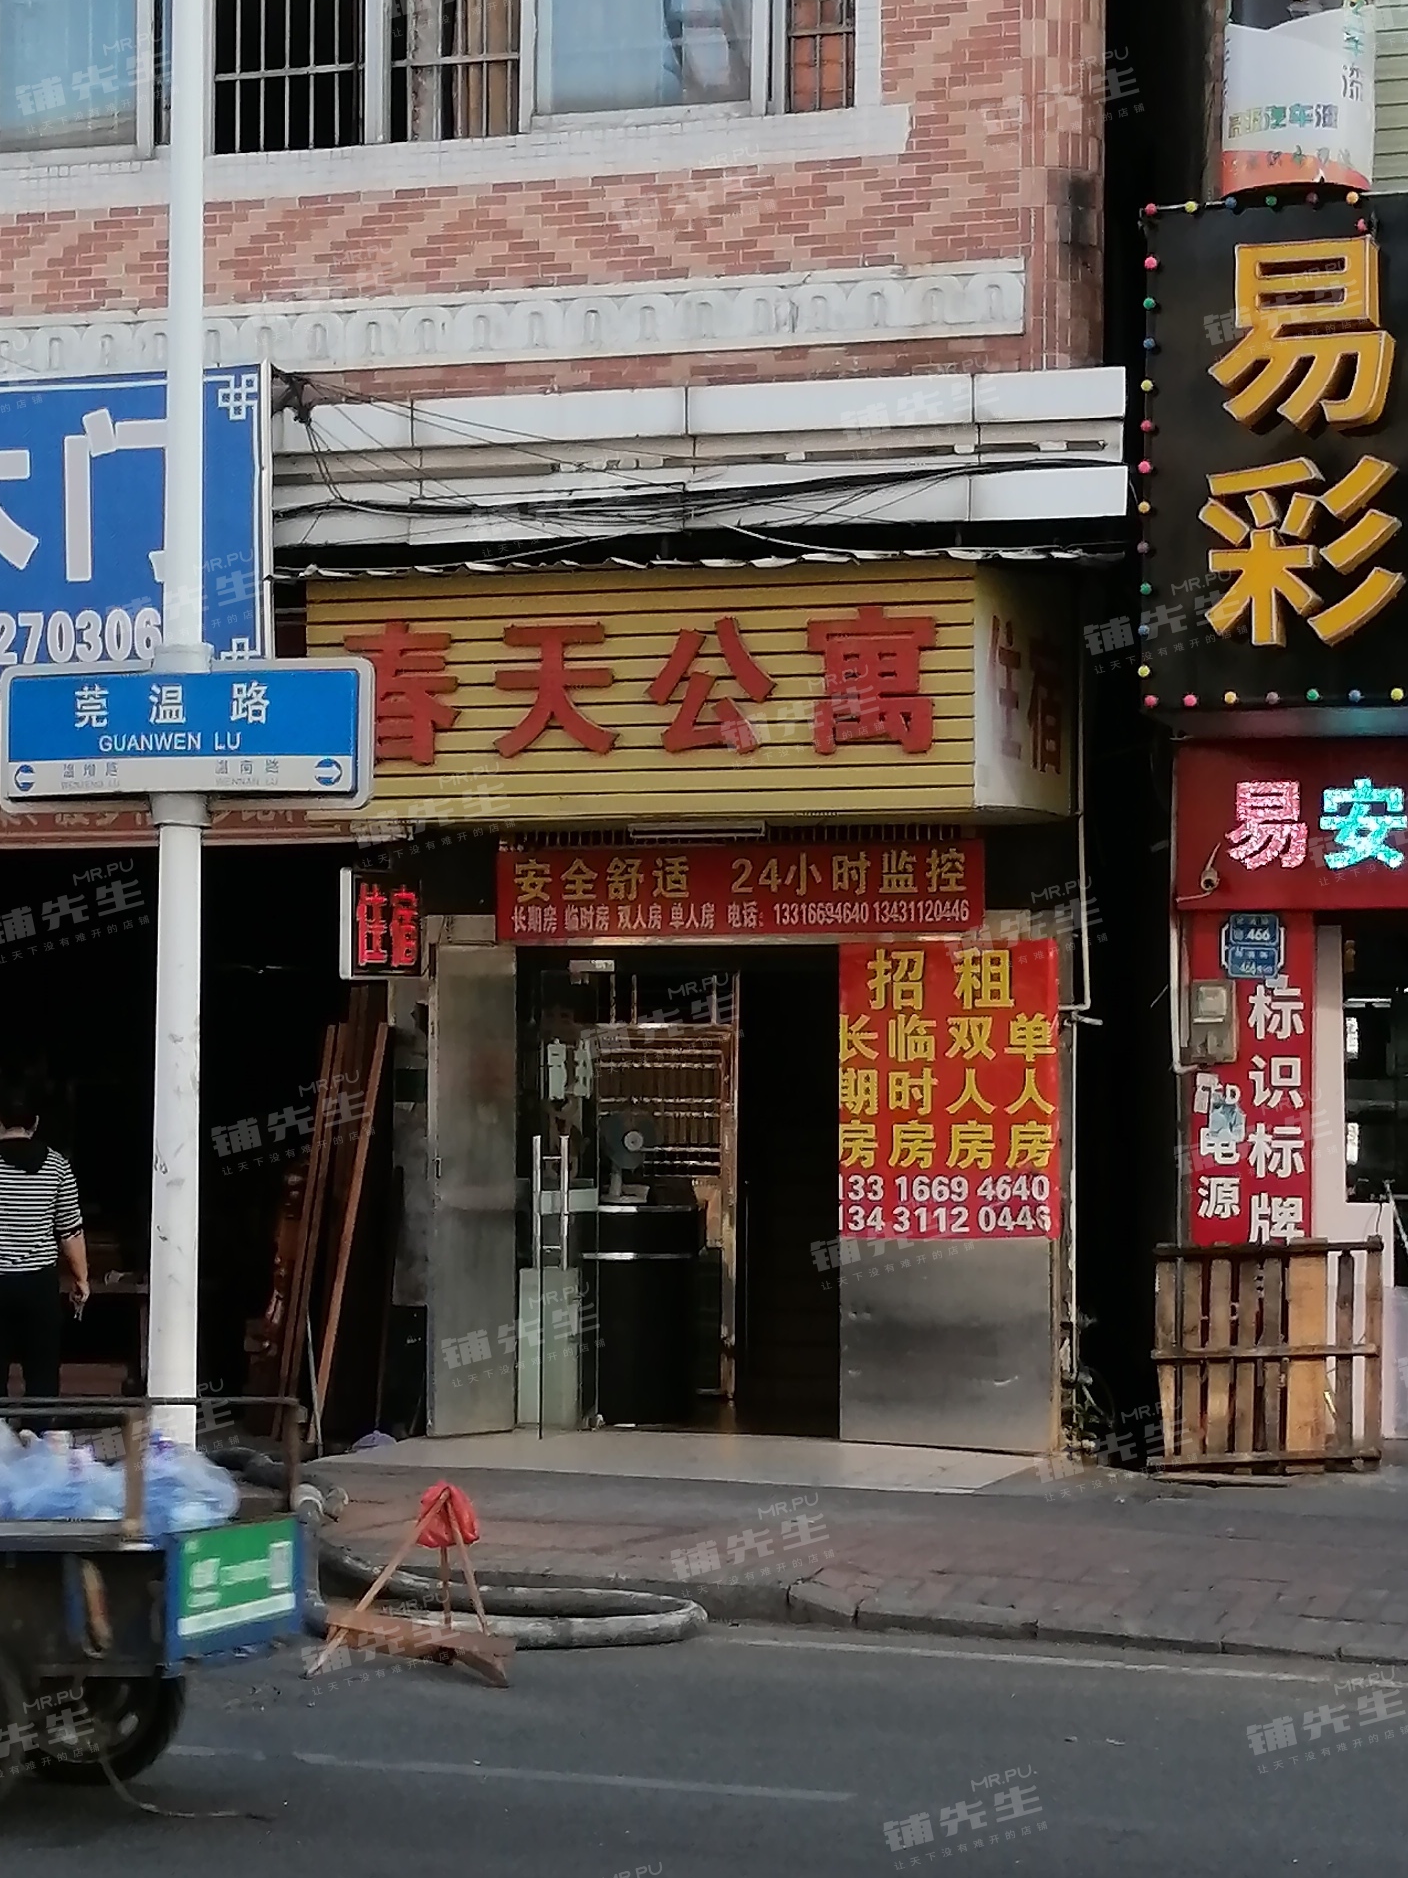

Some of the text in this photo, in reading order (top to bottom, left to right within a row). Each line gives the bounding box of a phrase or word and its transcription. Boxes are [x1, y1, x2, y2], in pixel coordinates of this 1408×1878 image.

[1198, 235, 1406, 647] 易彩
[74, 680, 271, 729] 莞温路
[344, 606, 939, 766] 春天公寓
[98, 730, 242, 754] GUANWEN LU
[513, 848, 969, 904] 安全舒适 24小时监控
[357, 883, 419, 968] 住宿
[510, 904, 558, 934] 长期房
[563, 903, 610, 932] 临时房
[616, 902, 662, 931] 双人房
[669, 902, 716, 931] 单人房
[773, 900, 869, 926] 13316694640
[872, 898, 970, 925] 13431120446
[866, 947, 1015, 1010] 招租
[888, 1012, 939, 1170] 临时房
[944, 1014, 998, 1170] 双人房
[1003, 1011, 1057, 1170] 单人房
[1247, 983, 1306, 1246] 标识标牌
[892, 1204, 970, 1234] 3112
[977, 1204, 1053, 1234] 0446
[894, 1175, 970, 1203] 1669
[976, 1174, 1051, 1203] 4640
